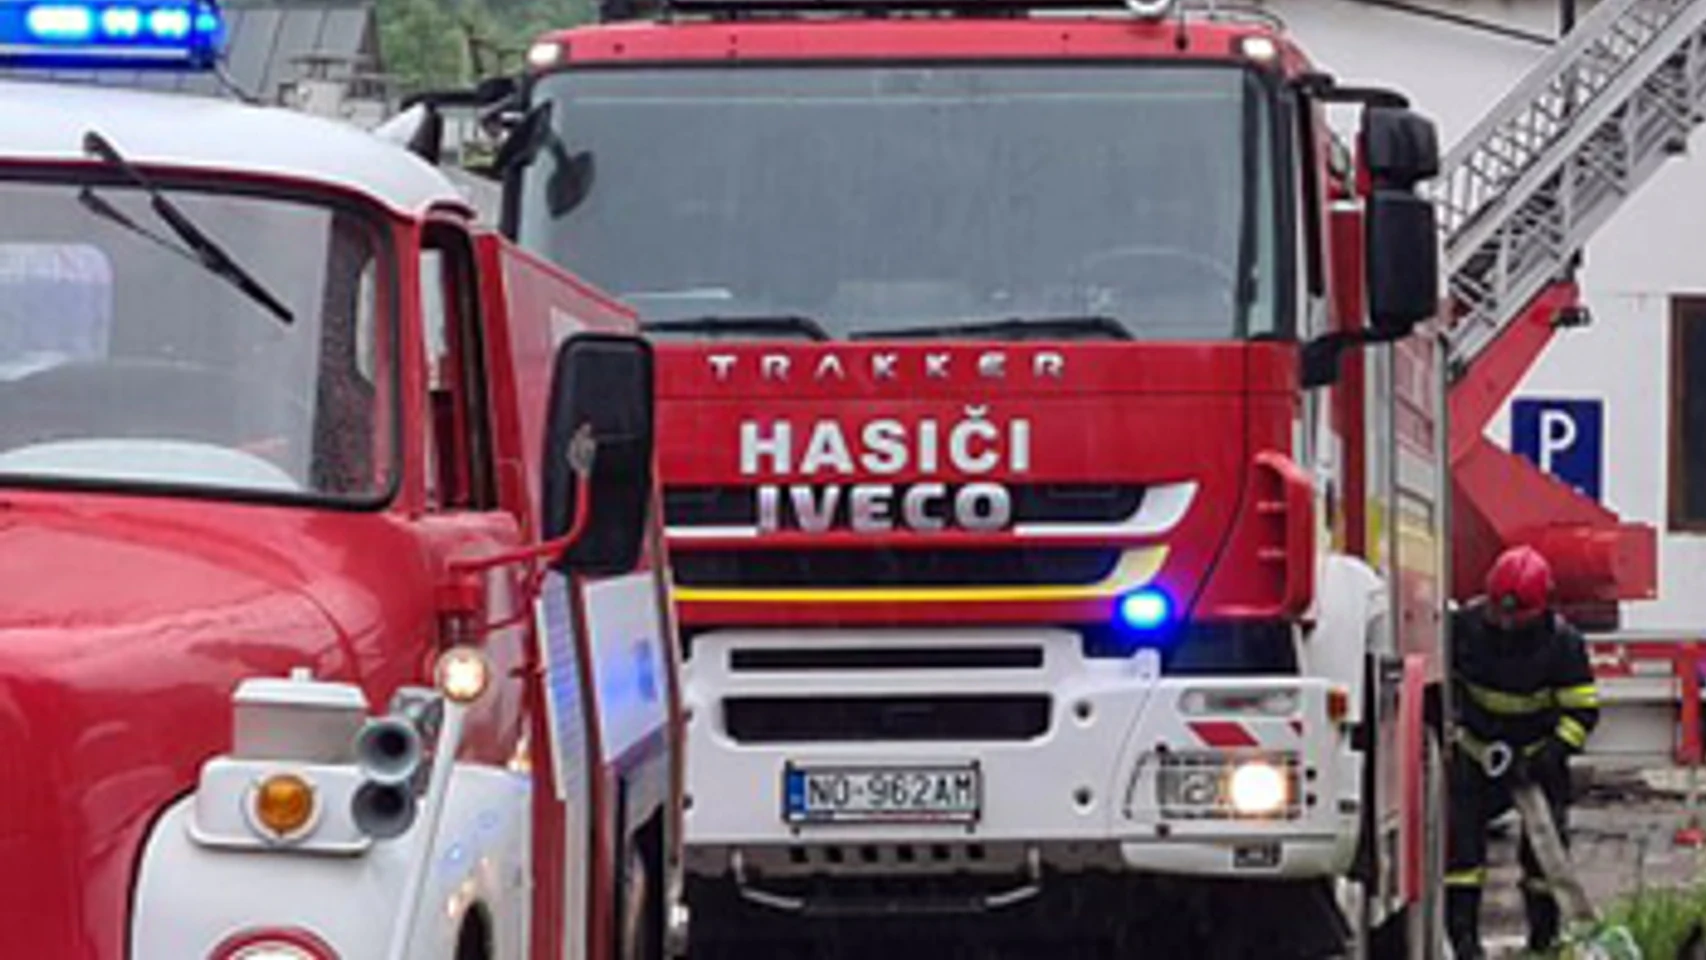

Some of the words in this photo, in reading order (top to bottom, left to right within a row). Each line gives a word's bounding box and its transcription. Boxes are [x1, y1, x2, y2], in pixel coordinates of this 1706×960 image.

[708, 352, 1066, 379] TRAKKER
[739, 405, 1031, 475] HASIČI
[1540, 409, 1577, 474] P
[756, 483, 1012, 532] IVECO
